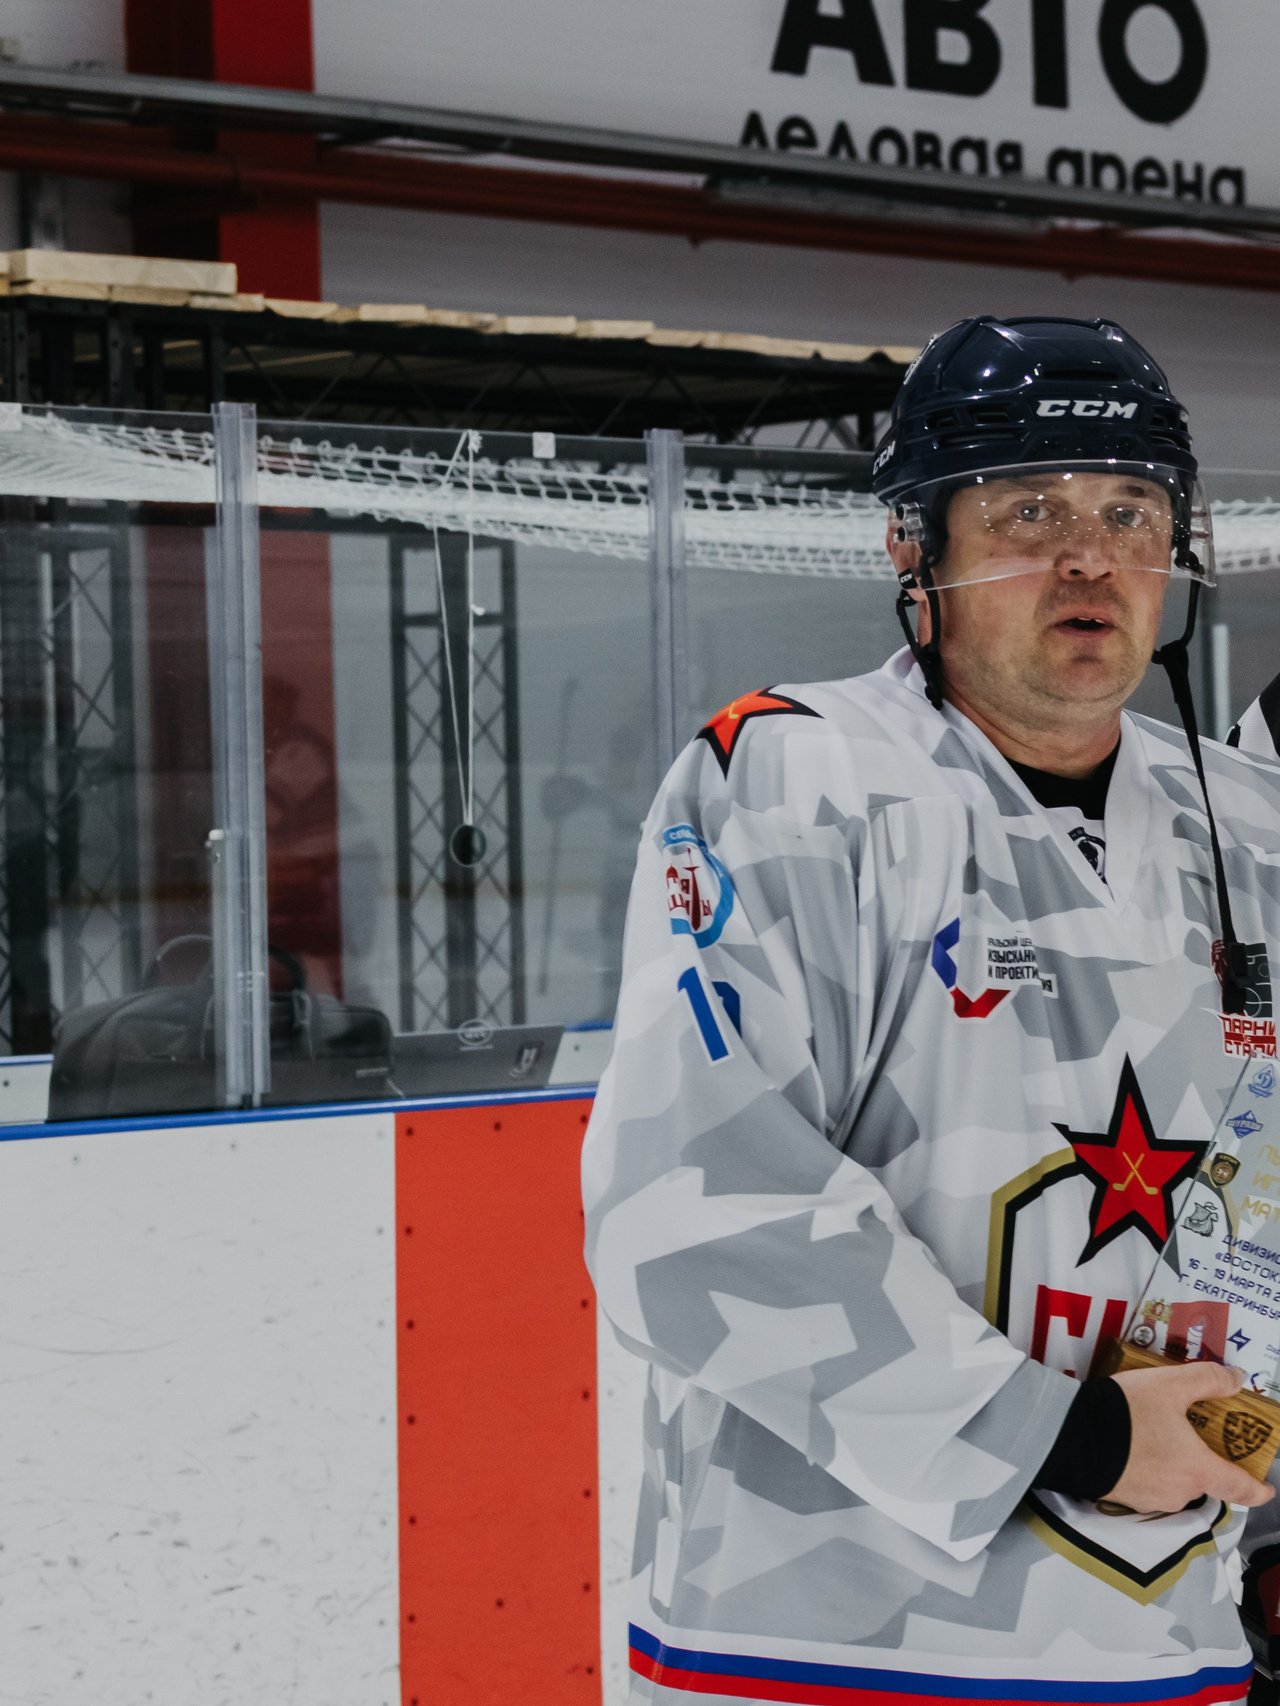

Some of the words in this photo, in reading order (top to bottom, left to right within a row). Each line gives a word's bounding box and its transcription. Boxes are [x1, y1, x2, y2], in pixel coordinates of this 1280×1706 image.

[1035, 400, 1138, 419] CCM
[872, 440, 896, 475] CCM
[1188, 1258, 1201, 1270] 16
[1214, 1268, 1226, 1280] 19
[1227, 1274, 1272, 1299] МАРТА
